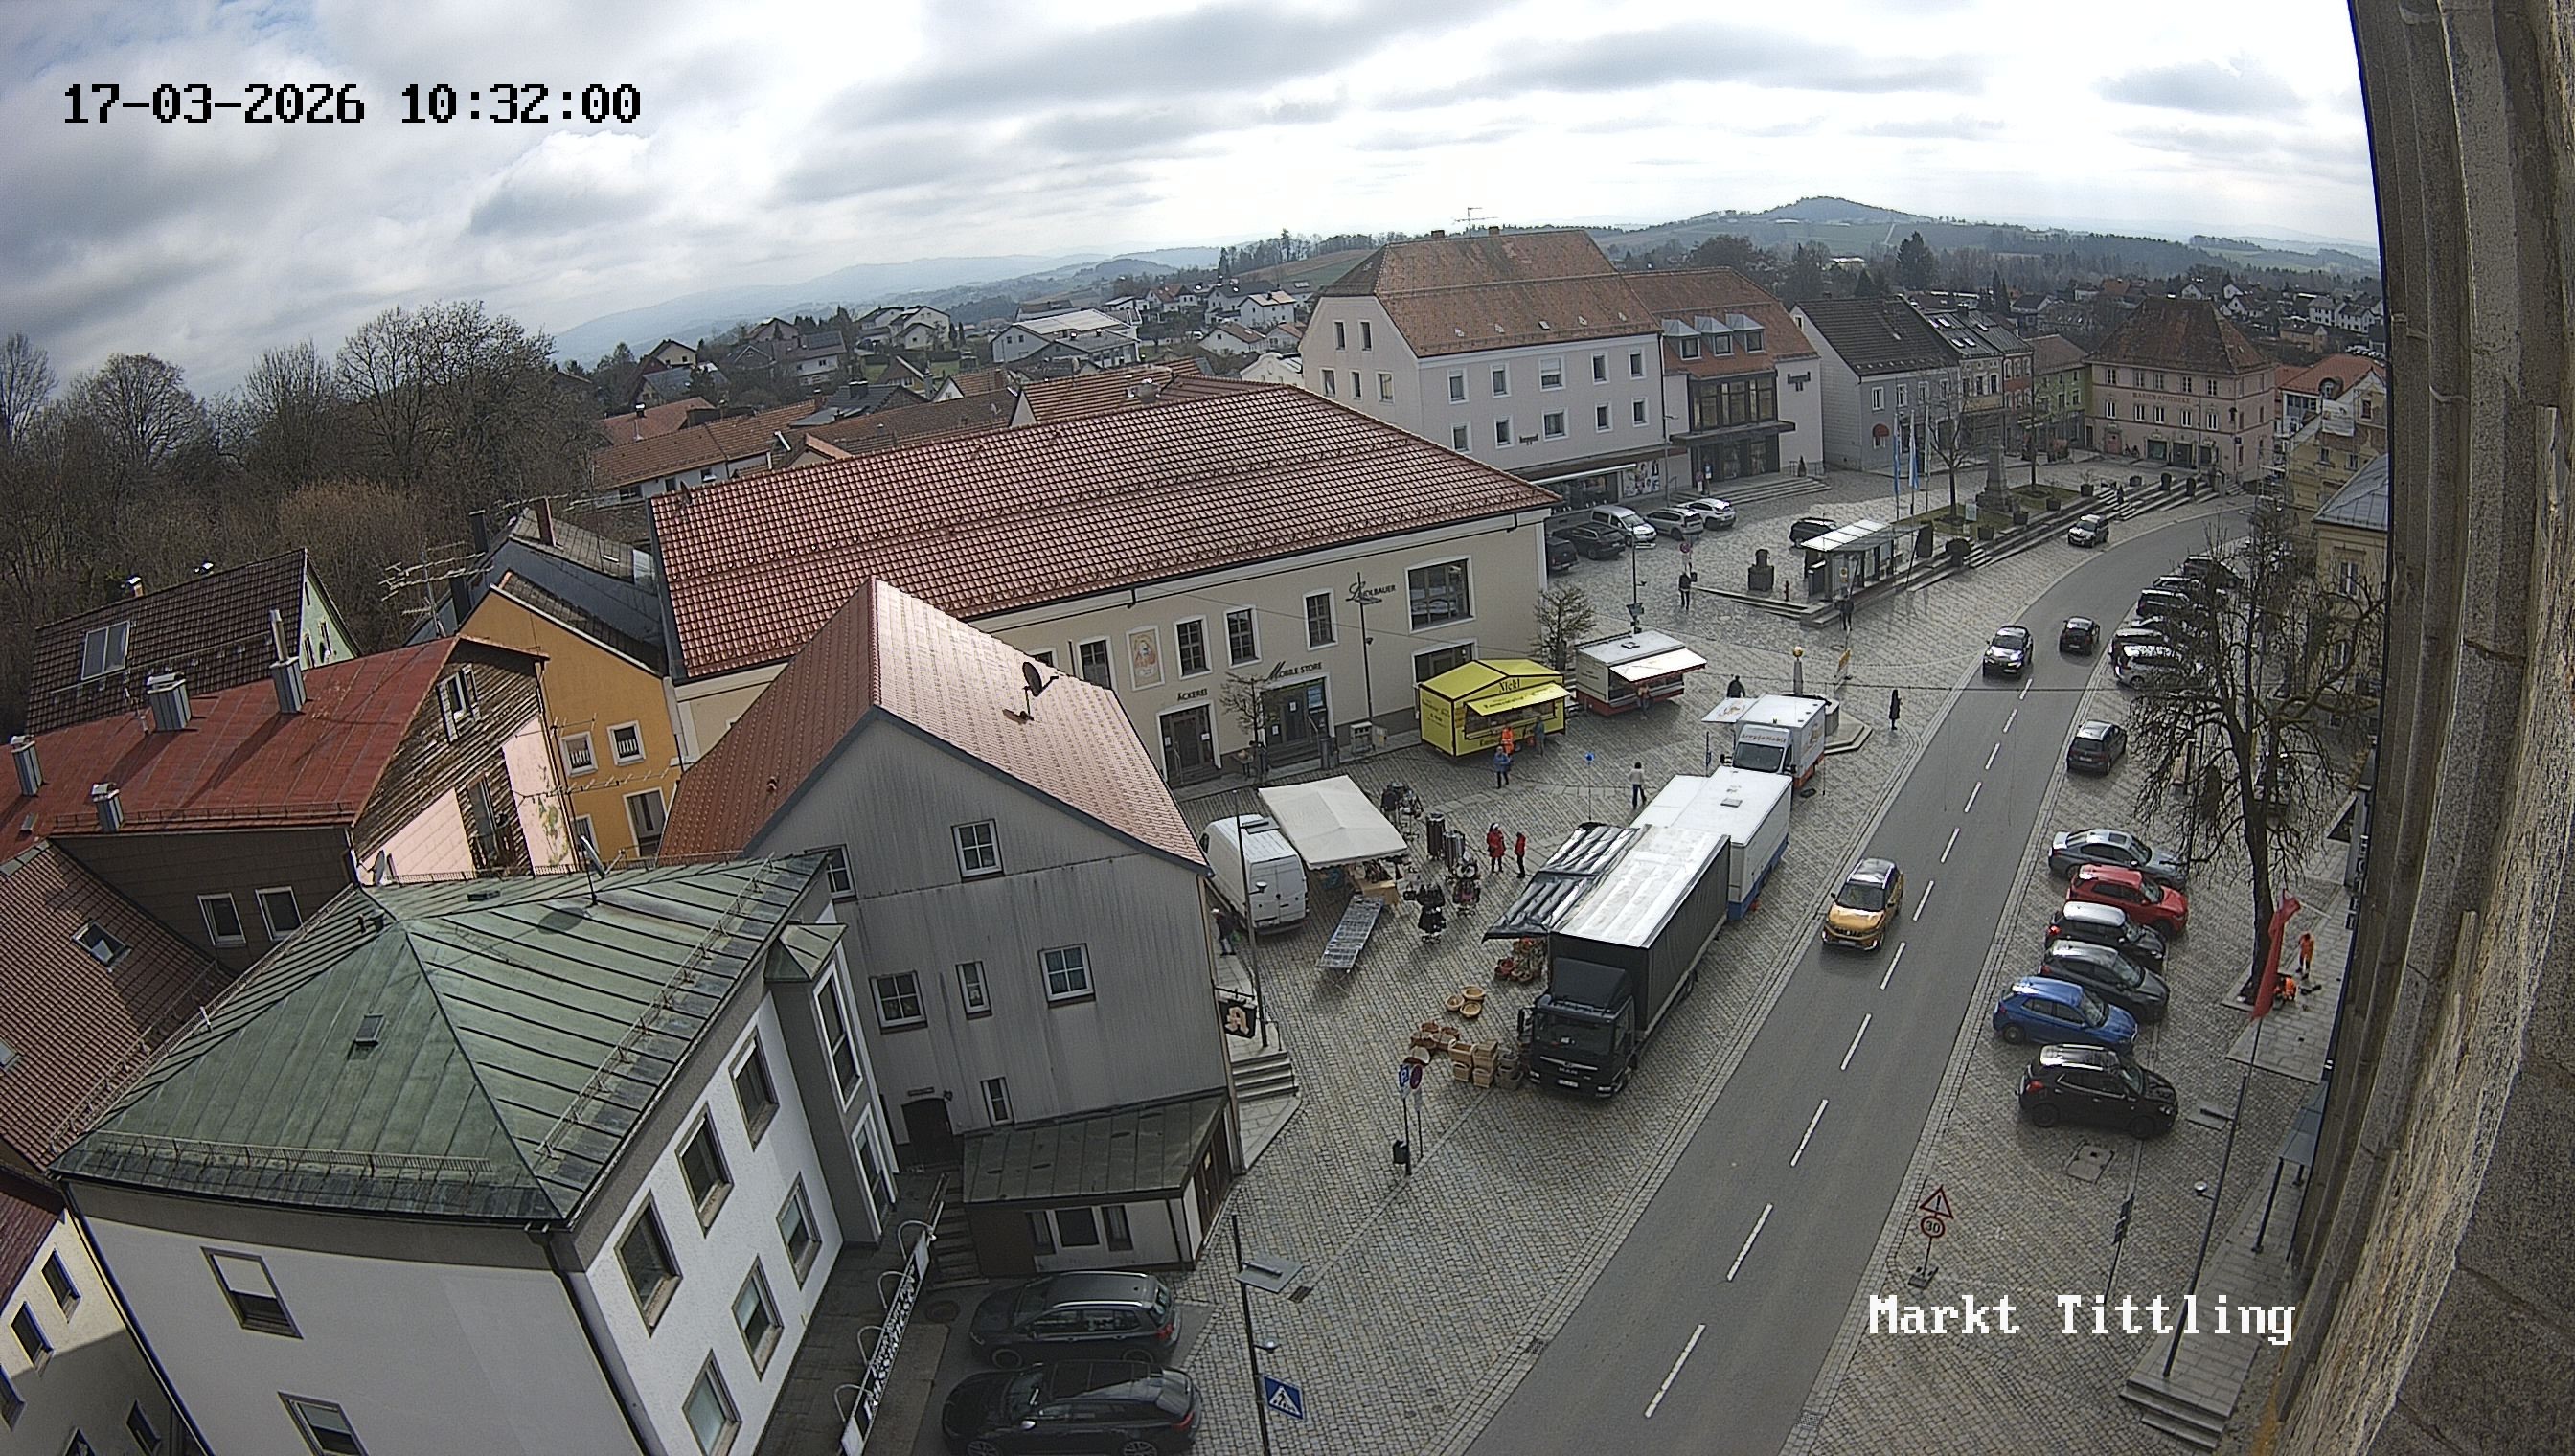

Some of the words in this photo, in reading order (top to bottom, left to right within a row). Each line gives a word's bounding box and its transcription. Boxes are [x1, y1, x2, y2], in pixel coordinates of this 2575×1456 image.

[1300, 662, 1322, 674] STORE
[1225, 1007, 1249, 1035] A
[1926, 1221, 1940, 1234] 30
